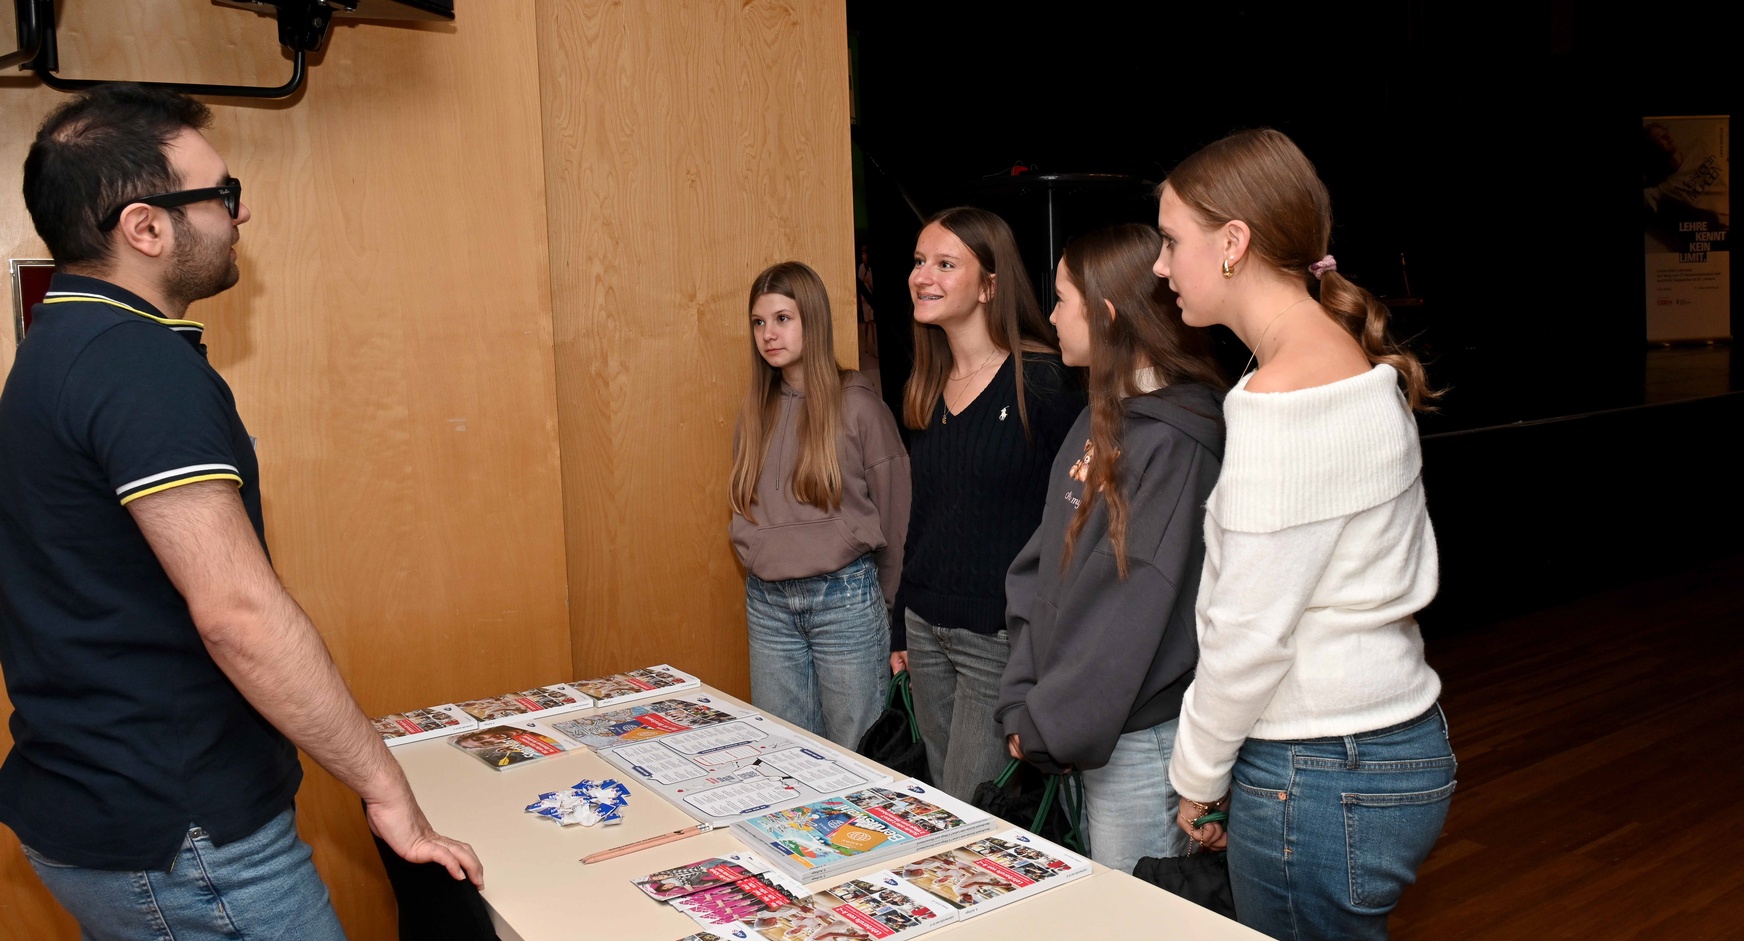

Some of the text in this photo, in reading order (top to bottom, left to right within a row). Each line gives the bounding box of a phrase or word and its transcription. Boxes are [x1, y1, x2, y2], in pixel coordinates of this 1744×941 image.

[1679, 221, 1708, 231] LEHRE
[1695, 231, 1727, 241] KENNT
[1689, 242, 1711, 252] KEIN
[1680, 252, 1707, 263] LIMIT.
[833, 804, 906, 842] Berufswahl
[855, 918, 882, 936] Lehrberufe
